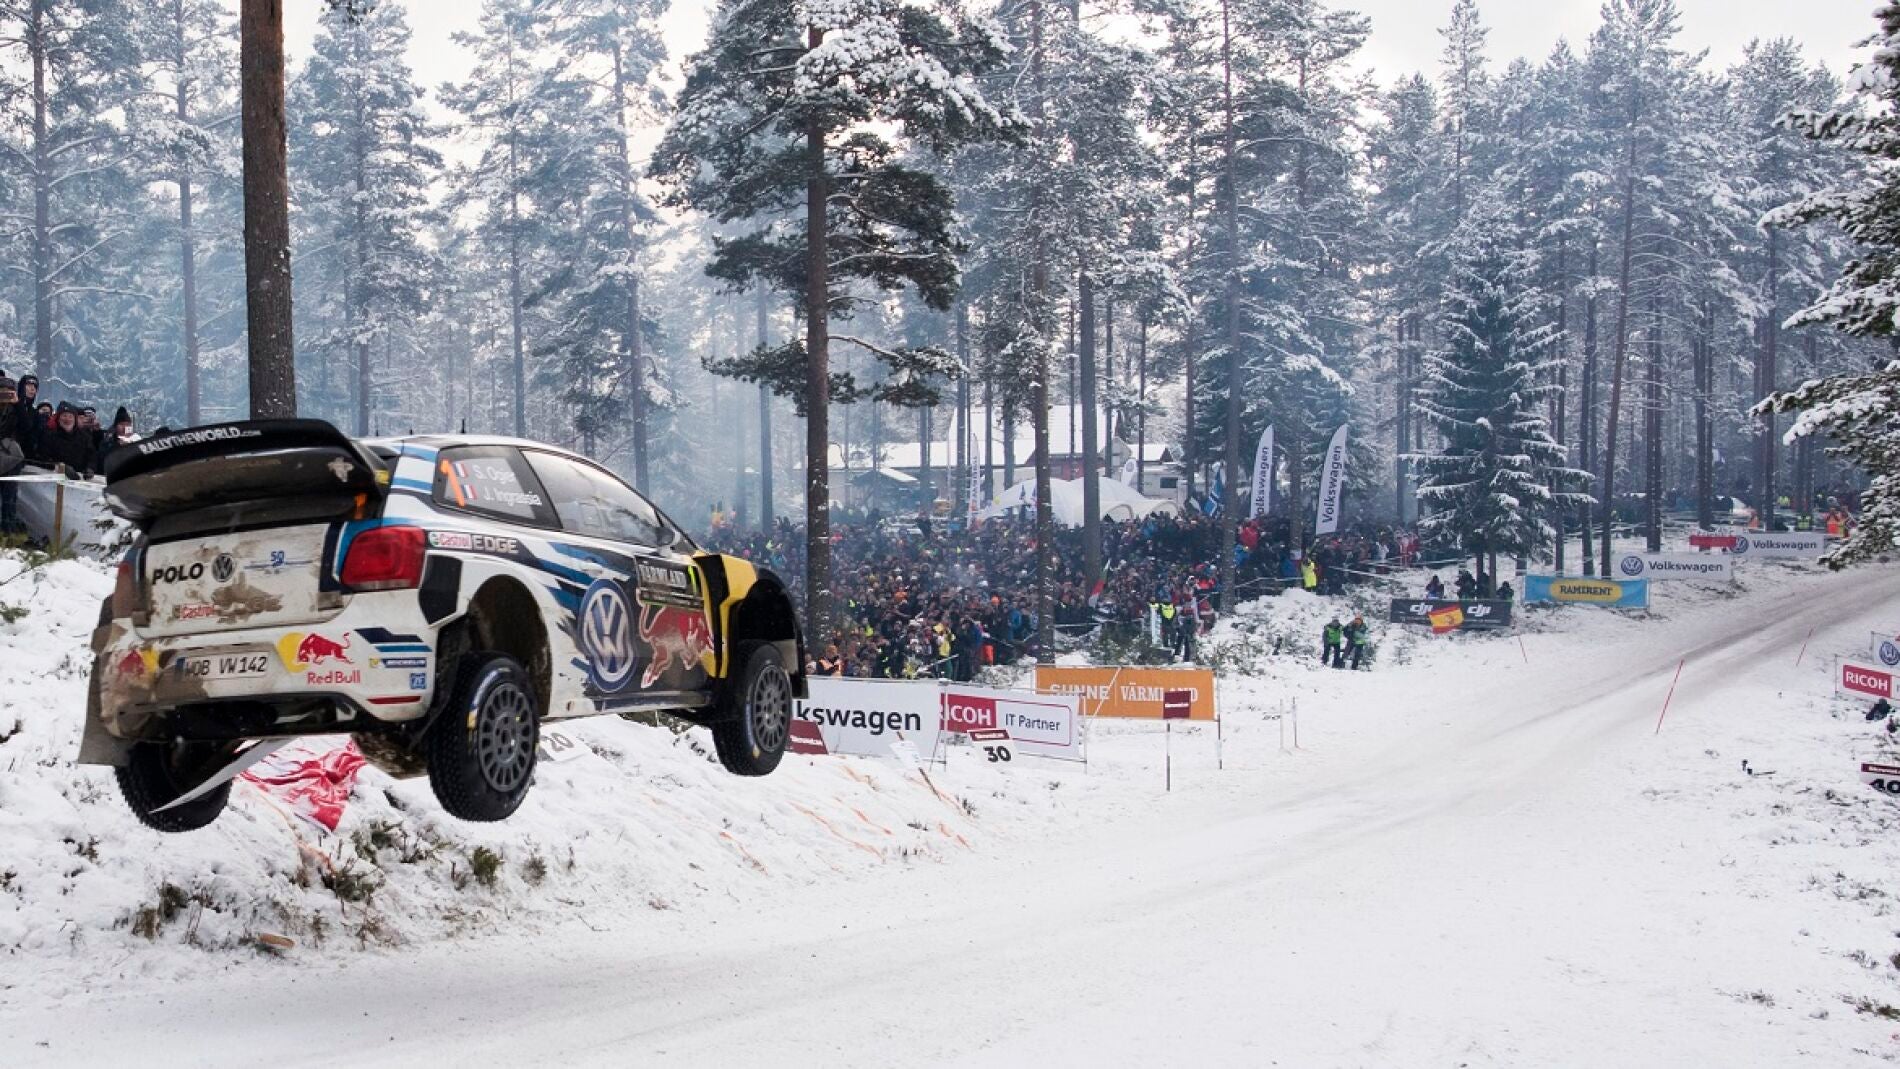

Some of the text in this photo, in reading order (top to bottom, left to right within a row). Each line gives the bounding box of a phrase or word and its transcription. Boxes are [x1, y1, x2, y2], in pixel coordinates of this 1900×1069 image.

[440, 458, 465, 508] 1
[1255, 447, 1270, 517] olkswagen
[1322, 446, 1343, 523] Volkswagen
[472, 535, 519, 554] EDGE
[1753, 540, 1818, 550] Volkswagen
[152, 563, 204, 585] POLO
[1648, 560, 1724, 573] Volkswagen
[307, 670, 361, 684] Red Bull
[1846, 671, 1888, 691] RICOH
[1120, 682, 1199, 702] VÄRMLD
[796, 700, 921, 736] kswagen
[1005, 713, 1061, 731] IT Partner
[983, 745, 1012, 763] 30
